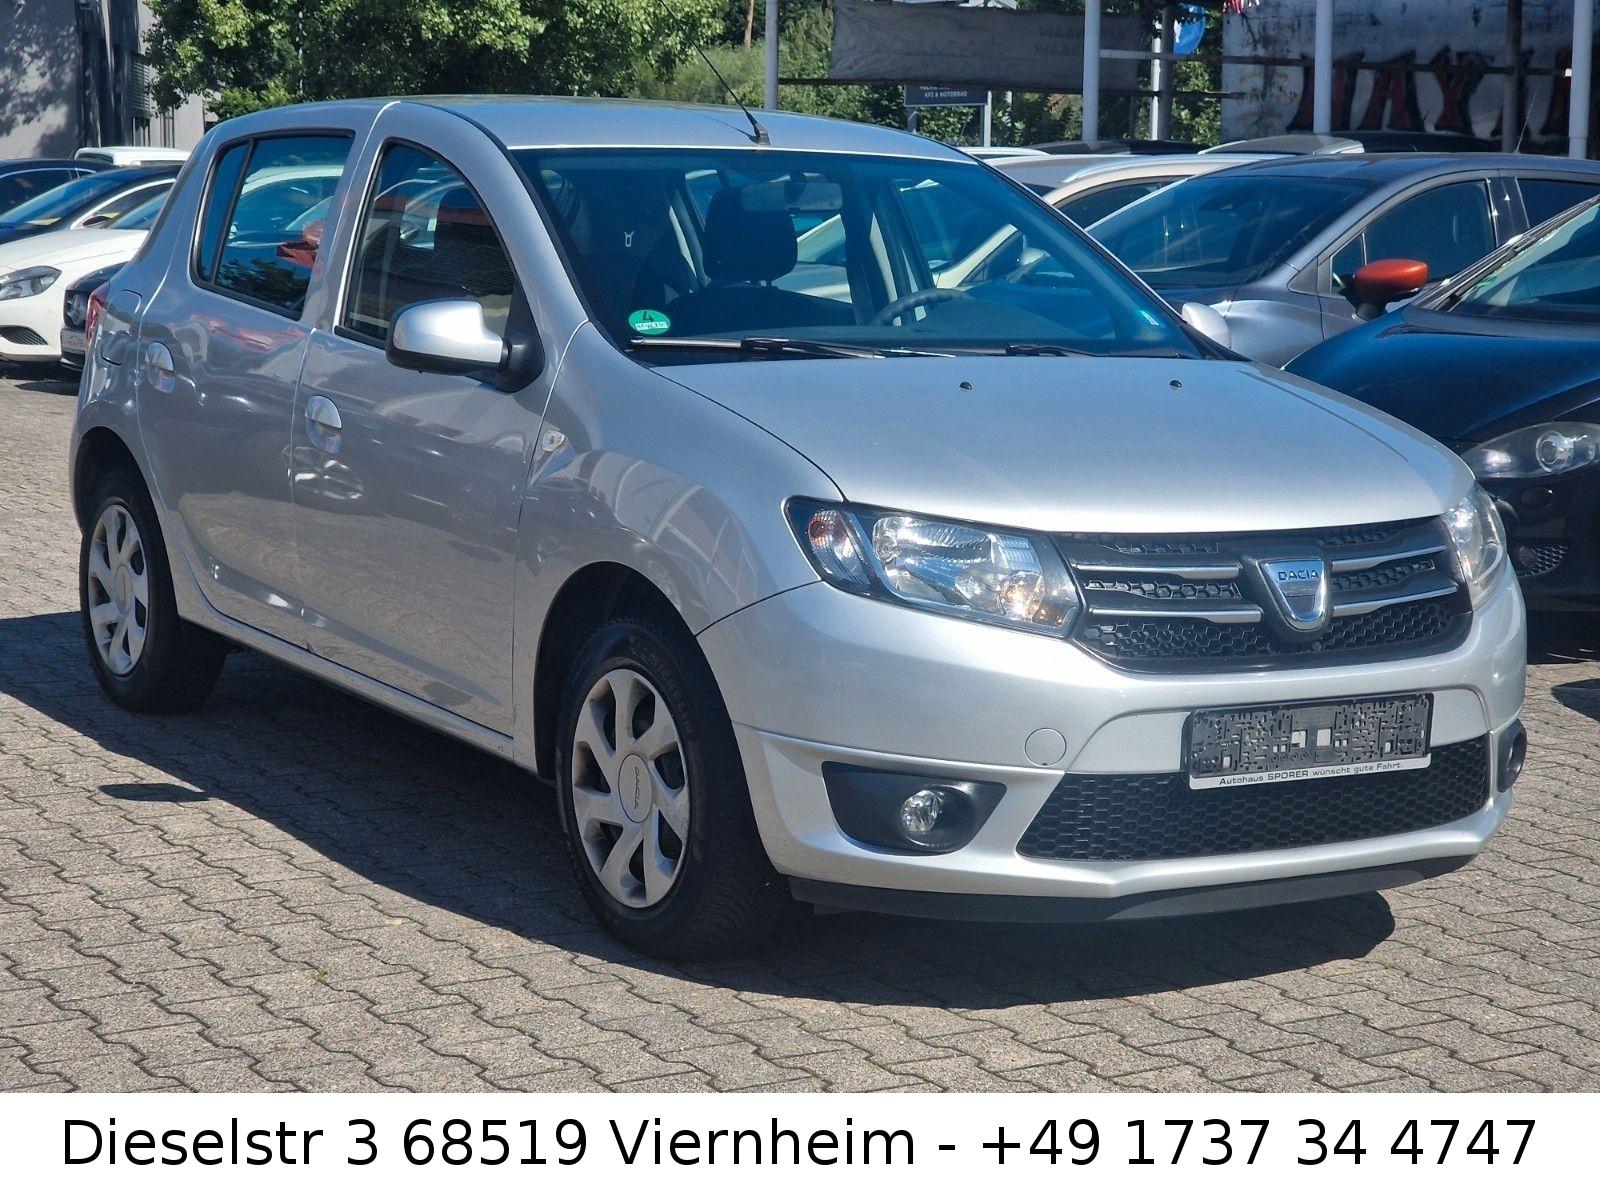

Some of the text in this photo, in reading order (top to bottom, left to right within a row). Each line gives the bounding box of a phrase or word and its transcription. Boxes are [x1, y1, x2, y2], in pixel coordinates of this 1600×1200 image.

[642, 310, 655, 322] 4
[1278, 569, 1320, 581] DACIA
[1219, 762, 1404, 786] Autohaus SPORER wünscht gute Fahrt.
